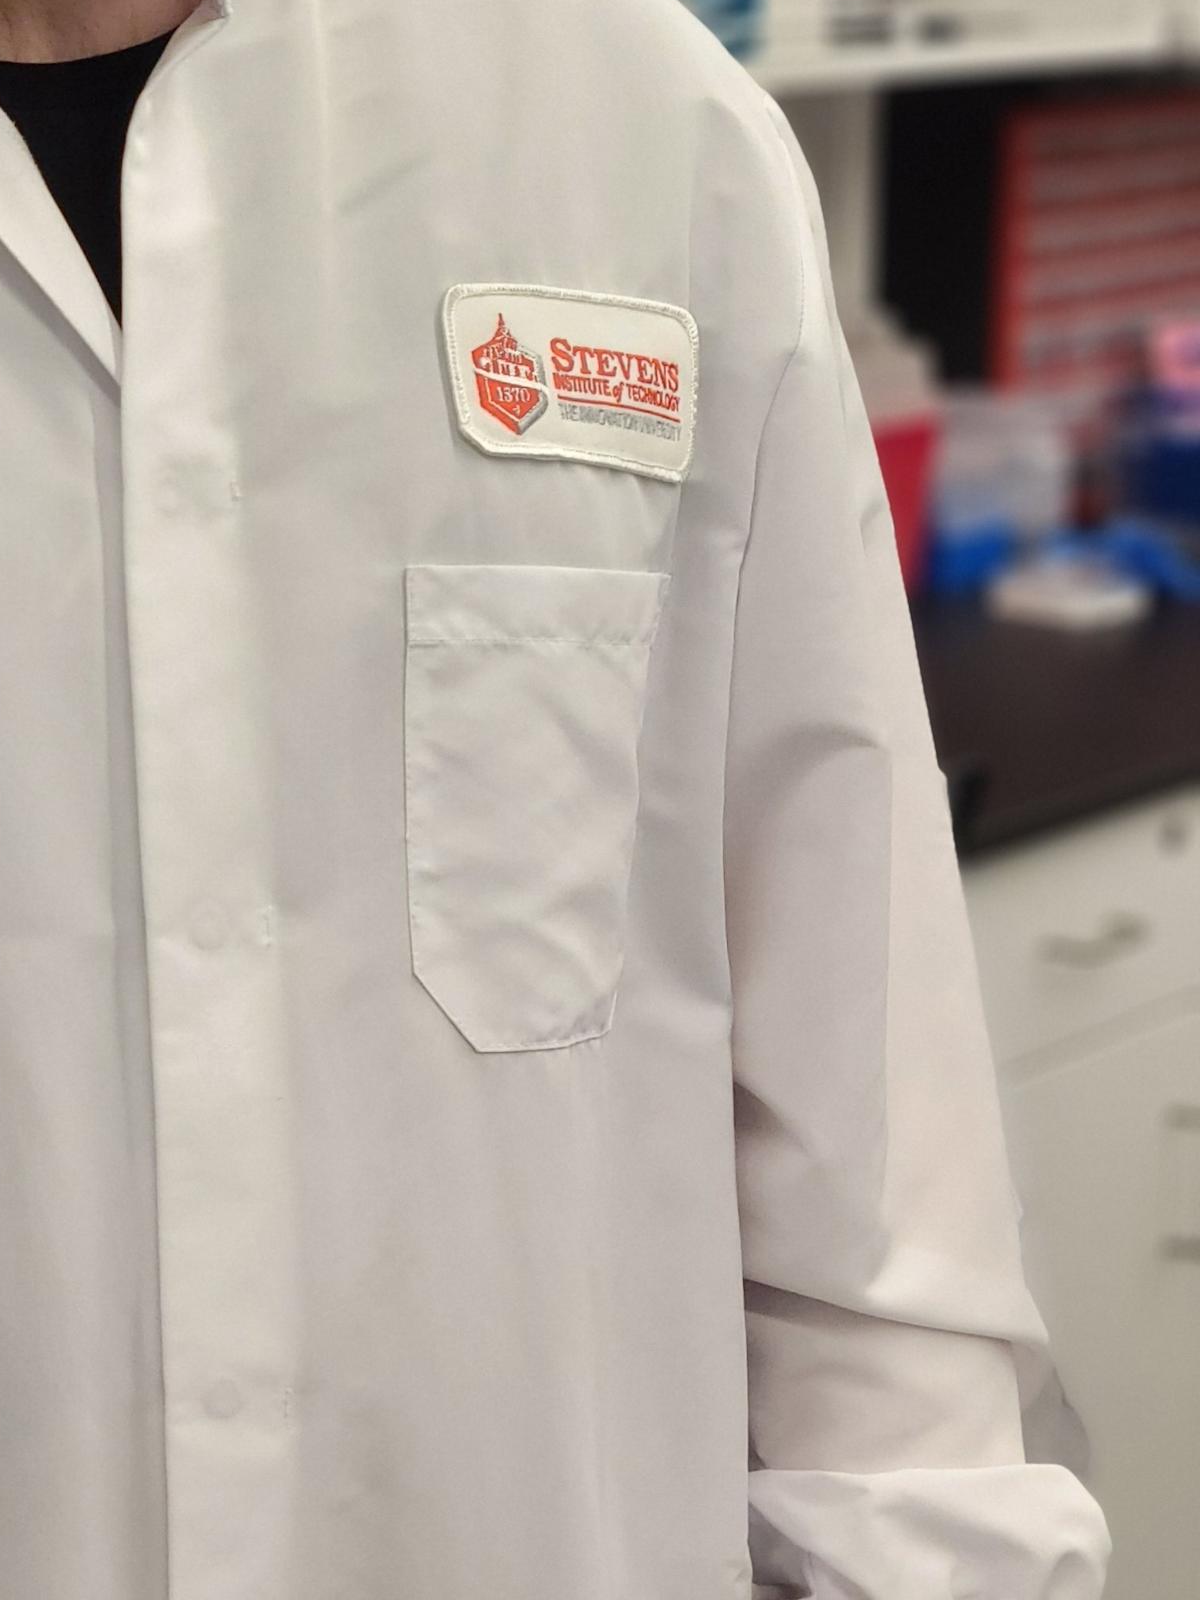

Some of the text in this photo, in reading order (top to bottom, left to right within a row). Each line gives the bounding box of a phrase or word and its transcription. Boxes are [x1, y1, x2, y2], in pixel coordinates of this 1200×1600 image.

[550, 337, 679, 392] STEVENS
[552, 372, 680, 412] INSTITUTE of TECHNOLOGY
